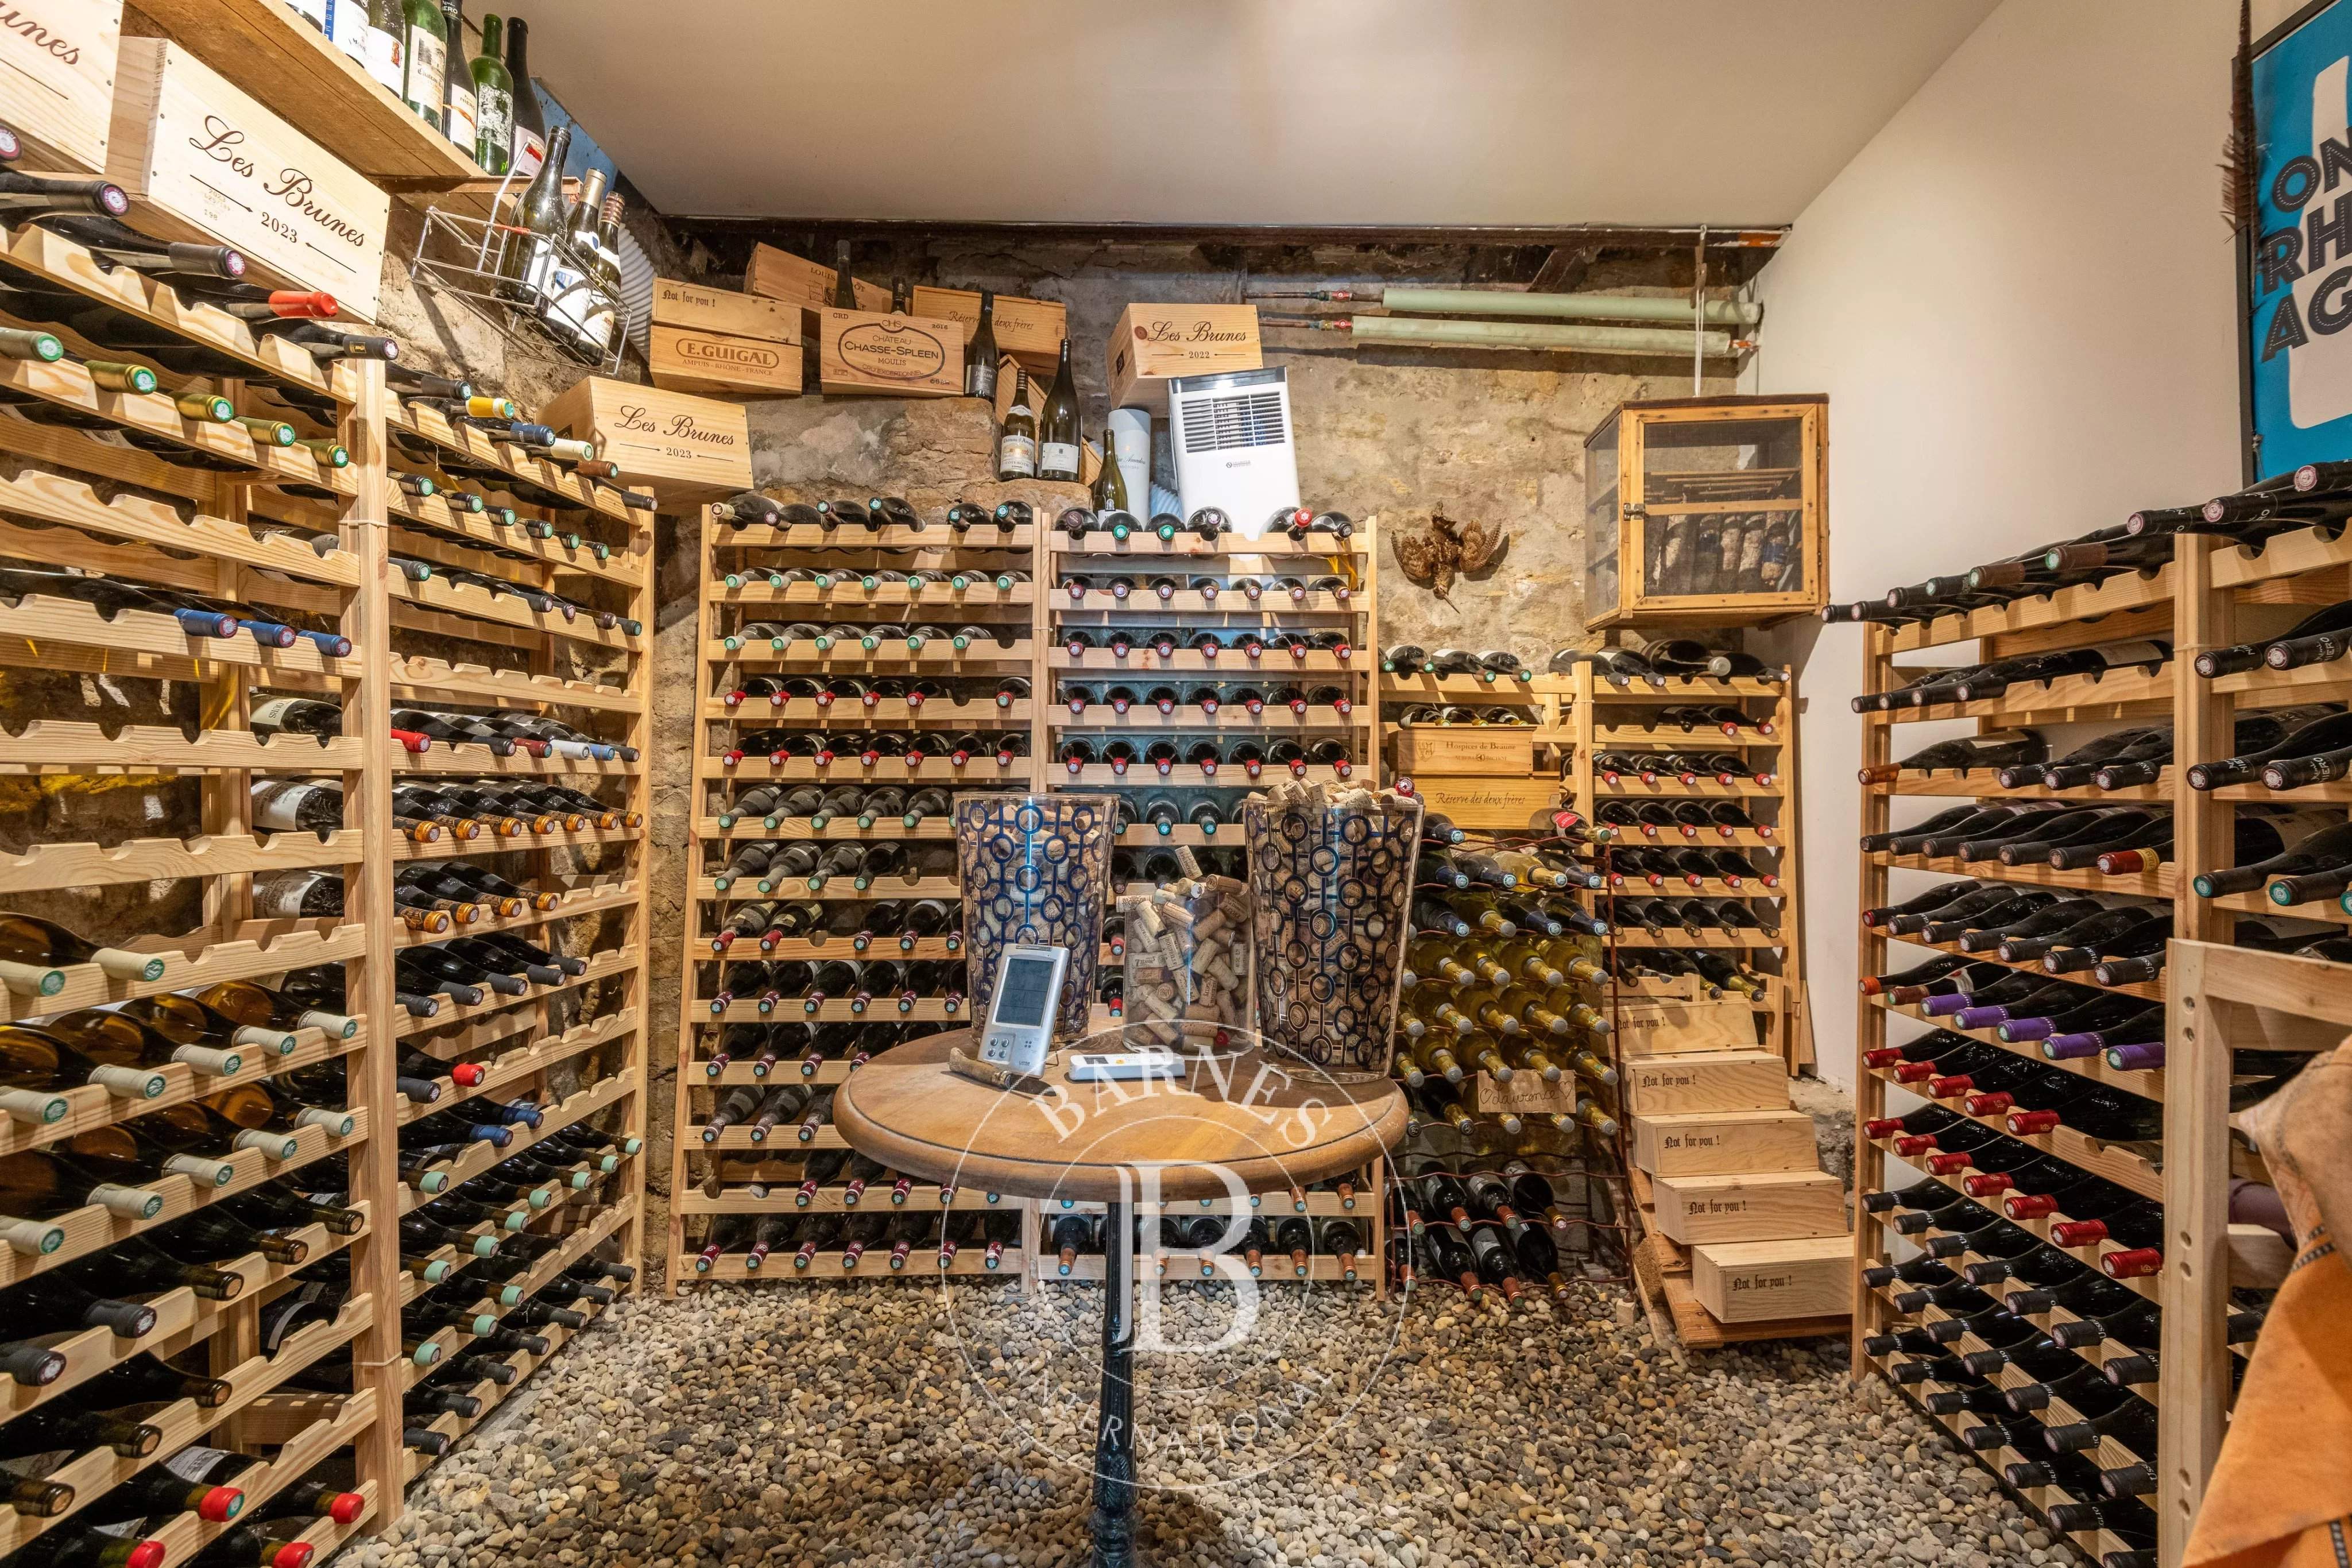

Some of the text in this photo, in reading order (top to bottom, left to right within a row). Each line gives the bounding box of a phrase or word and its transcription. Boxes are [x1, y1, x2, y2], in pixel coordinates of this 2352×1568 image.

[189, 115, 365, 247] Les Brunes
[261, 212, 297, 243] 2023
[810, 267, 836, 281] LOUIS
[662, 289, 678, 301] Not
[682, 291, 693, 303] for
[695, 297, 709, 307] you
[1147, 321, 1246, 342] Les Brunes
[687, 342, 771, 366] E.GUIGAL
[877, 357, 907, 366] MOULIS
[682, 359, 710, 367] AMPUIS
[746, 367, 773, 376] FRANCE
[614, 405, 734, 445] Les Brunes
[666, 447, 692, 459] 2023
[1446, 741, 1478, 751] Hospices
[1490, 742, 1516, 750] Beaune
[1436, 791, 1526, 809] Réserve des deux frères
[1633, 1016, 1645, 1028] for
[1646, 1019, 1659, 1030] you
[1642, 1075, 1658, 1087] Not
[1662, 1073, 1673, 1086] for
[1676, 1076, 1689, 1087] you
[1665, 1136, 1680, 1149] Not
[1685, 1133, 1696, 1147] for
[1699, 1137, 1713, 1149] you
[1688, 1201, 1705, 1214] Not
[1709, 1199, 1722, 1214] for
[1724, 1202, 1740, 1214] you
[1732, 1277, 1750, 1291] Not
[1754, 1274, 1767, 1290] for
[1769, 1277, 1785, 1290] you
